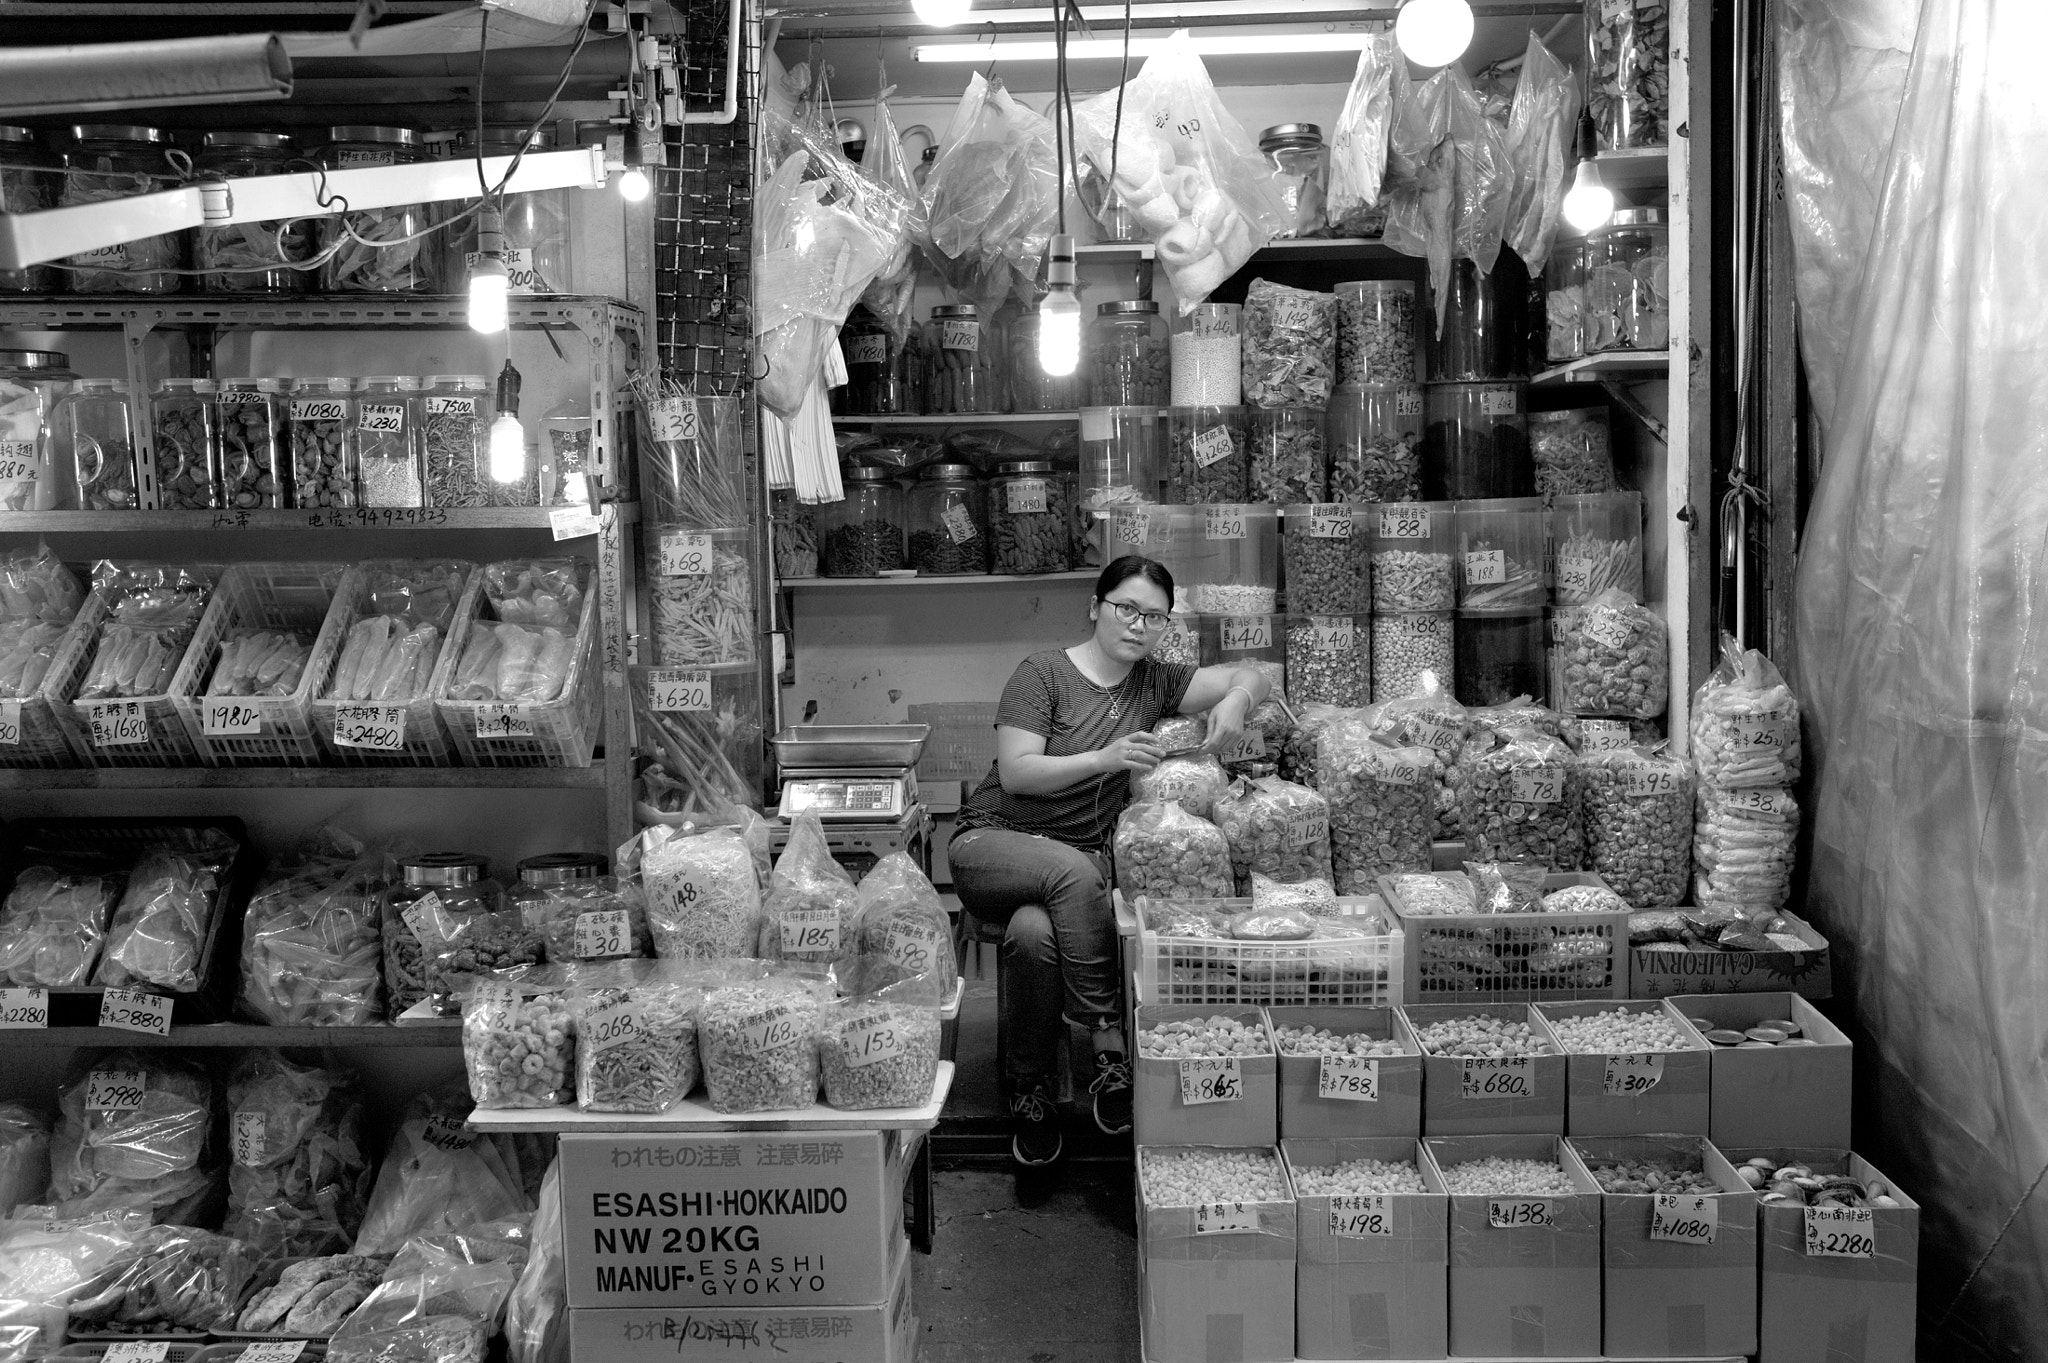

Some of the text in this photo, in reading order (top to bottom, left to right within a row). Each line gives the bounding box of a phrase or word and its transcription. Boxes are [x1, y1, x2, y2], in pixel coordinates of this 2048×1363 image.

[1637, 951, 1756, 975] CALIFORNIA
[611, 1142, 845, 1168] われもの注意 注意易碎
[594, 1224, 760, 1255] NW 20KG
[699, 1254, 825, 1276] ESASHI
[701, 1274, 825, 1296] GYOKYO
